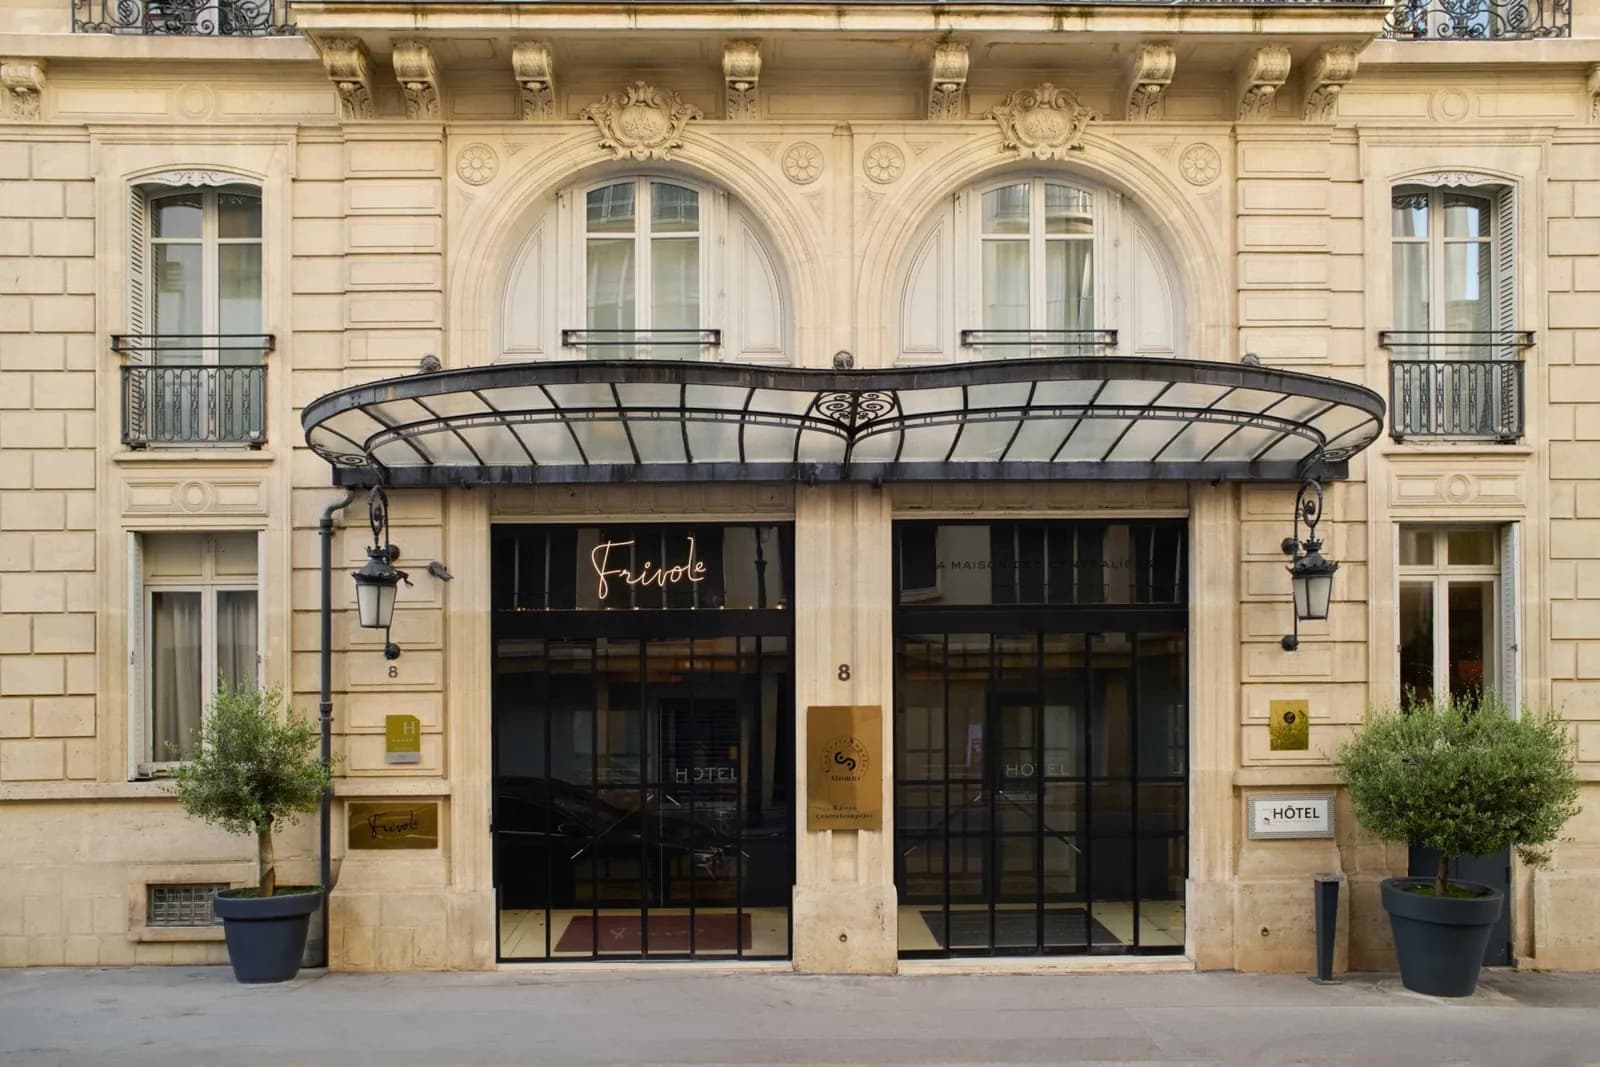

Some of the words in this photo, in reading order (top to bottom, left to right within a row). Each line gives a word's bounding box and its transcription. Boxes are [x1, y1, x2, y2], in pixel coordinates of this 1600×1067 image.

[591, 536, 707, 600] Frivole
[388, 665, 399, 678] 8
[837, 663, 851, 682] 8
[403, 720, 416, 735] H
[1006, 762, 1072, 777] HOEL
[1273, 804, 1321, 819] HÔTEL
